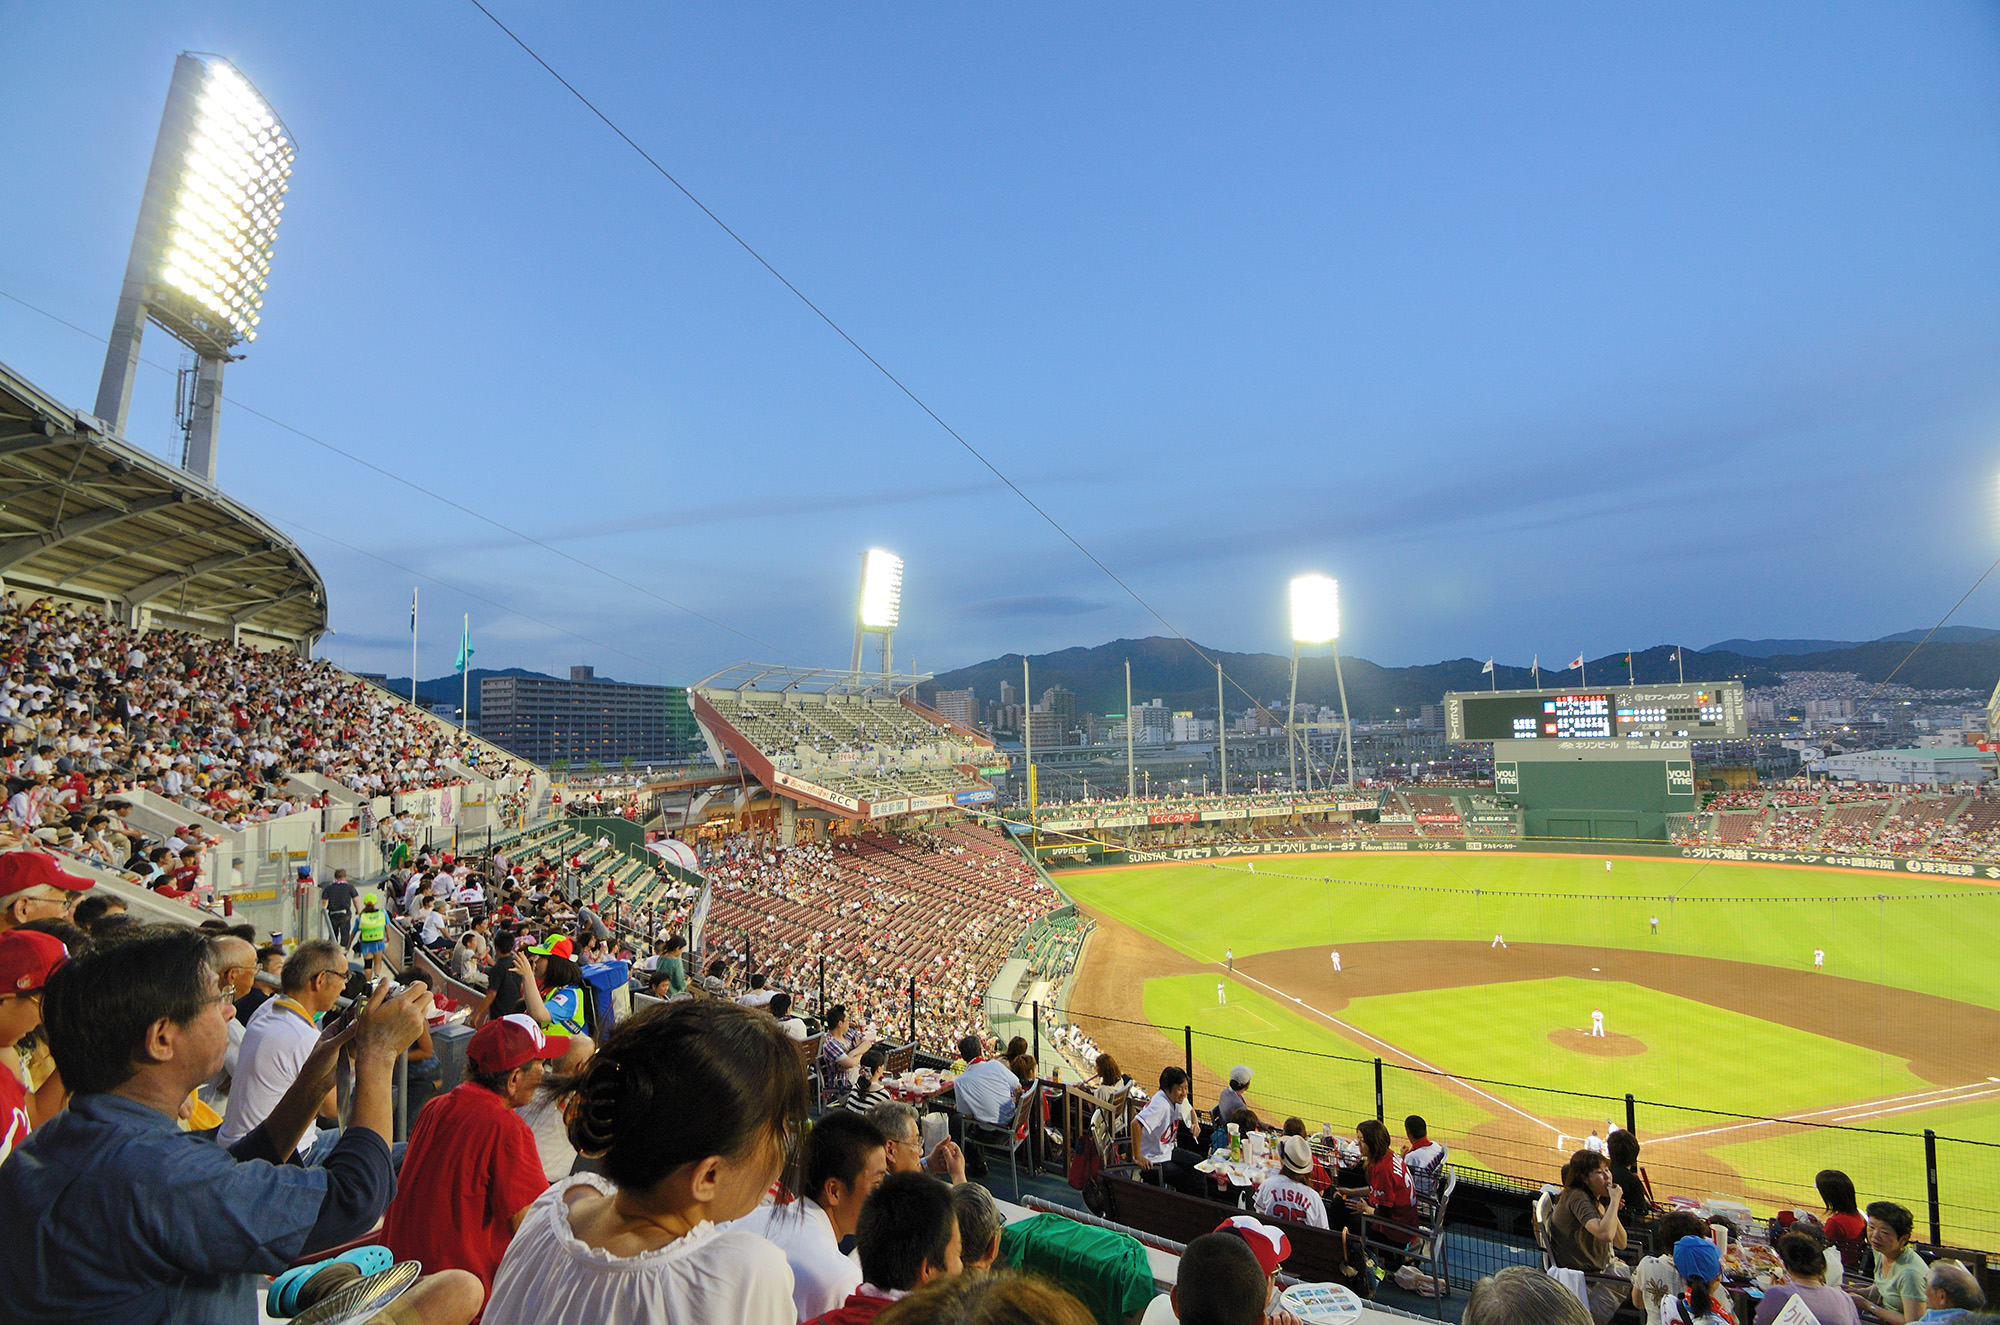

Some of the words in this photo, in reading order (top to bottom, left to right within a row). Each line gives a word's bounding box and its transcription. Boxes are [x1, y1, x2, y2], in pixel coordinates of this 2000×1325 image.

[1449, 699, 1460, 740] アサヒビール
[1575, 741, 1619, 750] キリンビール
[1660, 740, 1688, 749] ムロオ
[1496, 769, 1516, 779] you
[1668, 769, 1690, 779] you
[1500, 777, 1517, 785] me
[1672, 777, 1692, 785] me
[829, 793, 852, 807] RCC
[1154, 813, 1195, 823] CGCグループ
[1273, 843, 1308, 853] ユウベル
[1128, 851, 1168, 863] SUNSTAR
[1173, 847, 1211, 860] クマヒラ
[1691, 847, 1748, 861] ダルマ焼酎
[1750, 851, 1792, 861] フマキラー
[1836, 856, 1895, 870] 中國新聞
[1921, 861, 1976, 876] 東洋証券
[1271, 1188, 1311, 1211] T.ISHII
